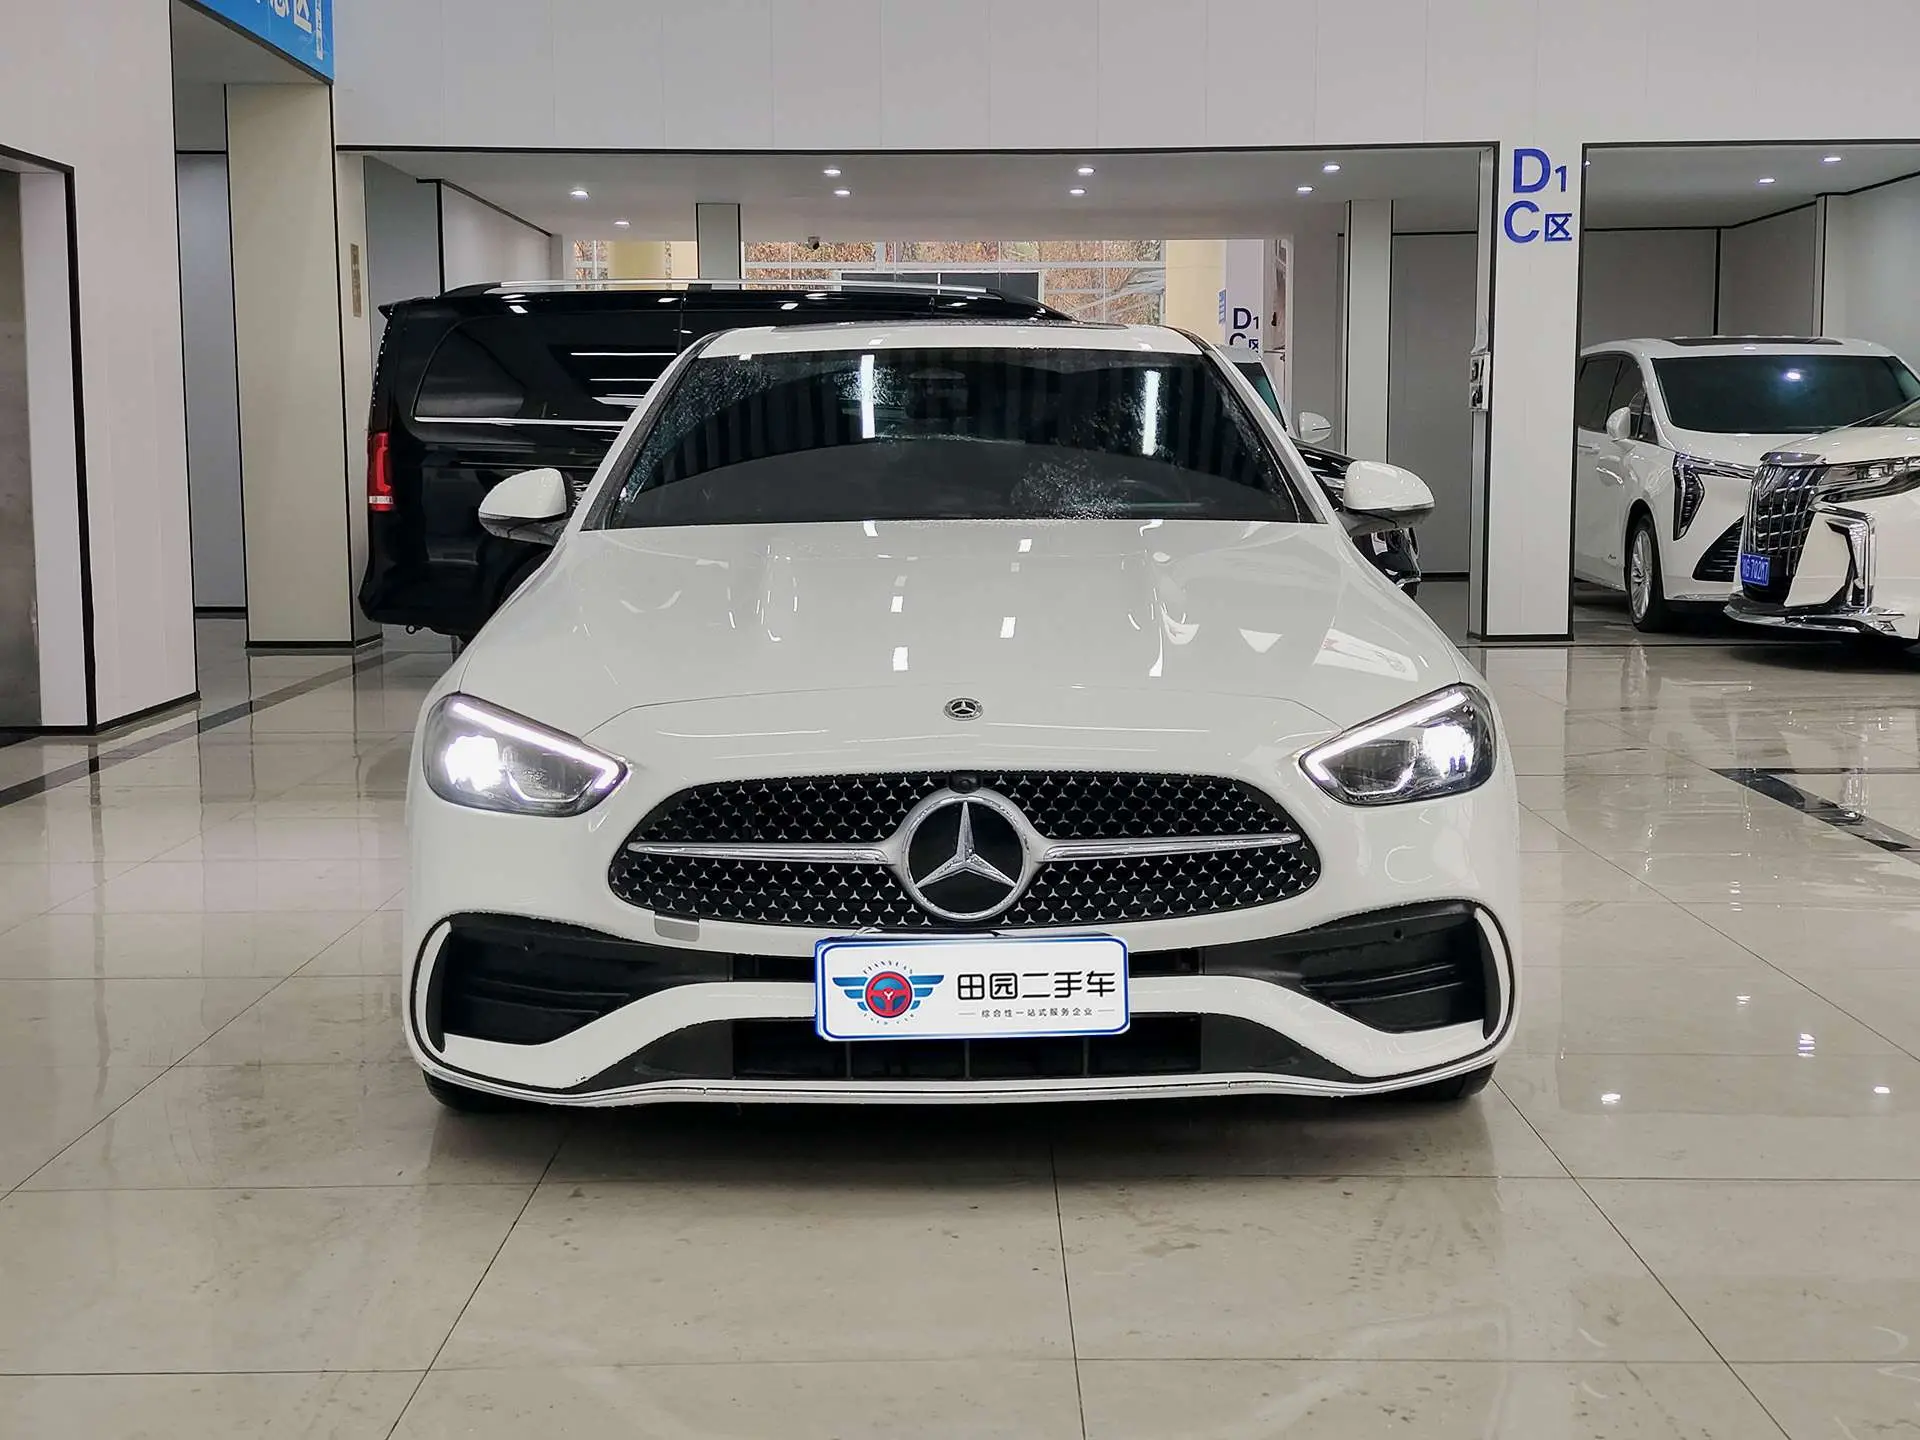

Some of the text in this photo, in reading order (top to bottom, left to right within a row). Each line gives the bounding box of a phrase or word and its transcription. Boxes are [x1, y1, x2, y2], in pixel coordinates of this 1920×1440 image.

[1513, 148, 1567, 193] D1
[1504, 200, 1573, 244] C区
[1233, 307, 1259, 330] D1
[957, 970, 1116, 1001] 田园二手车
